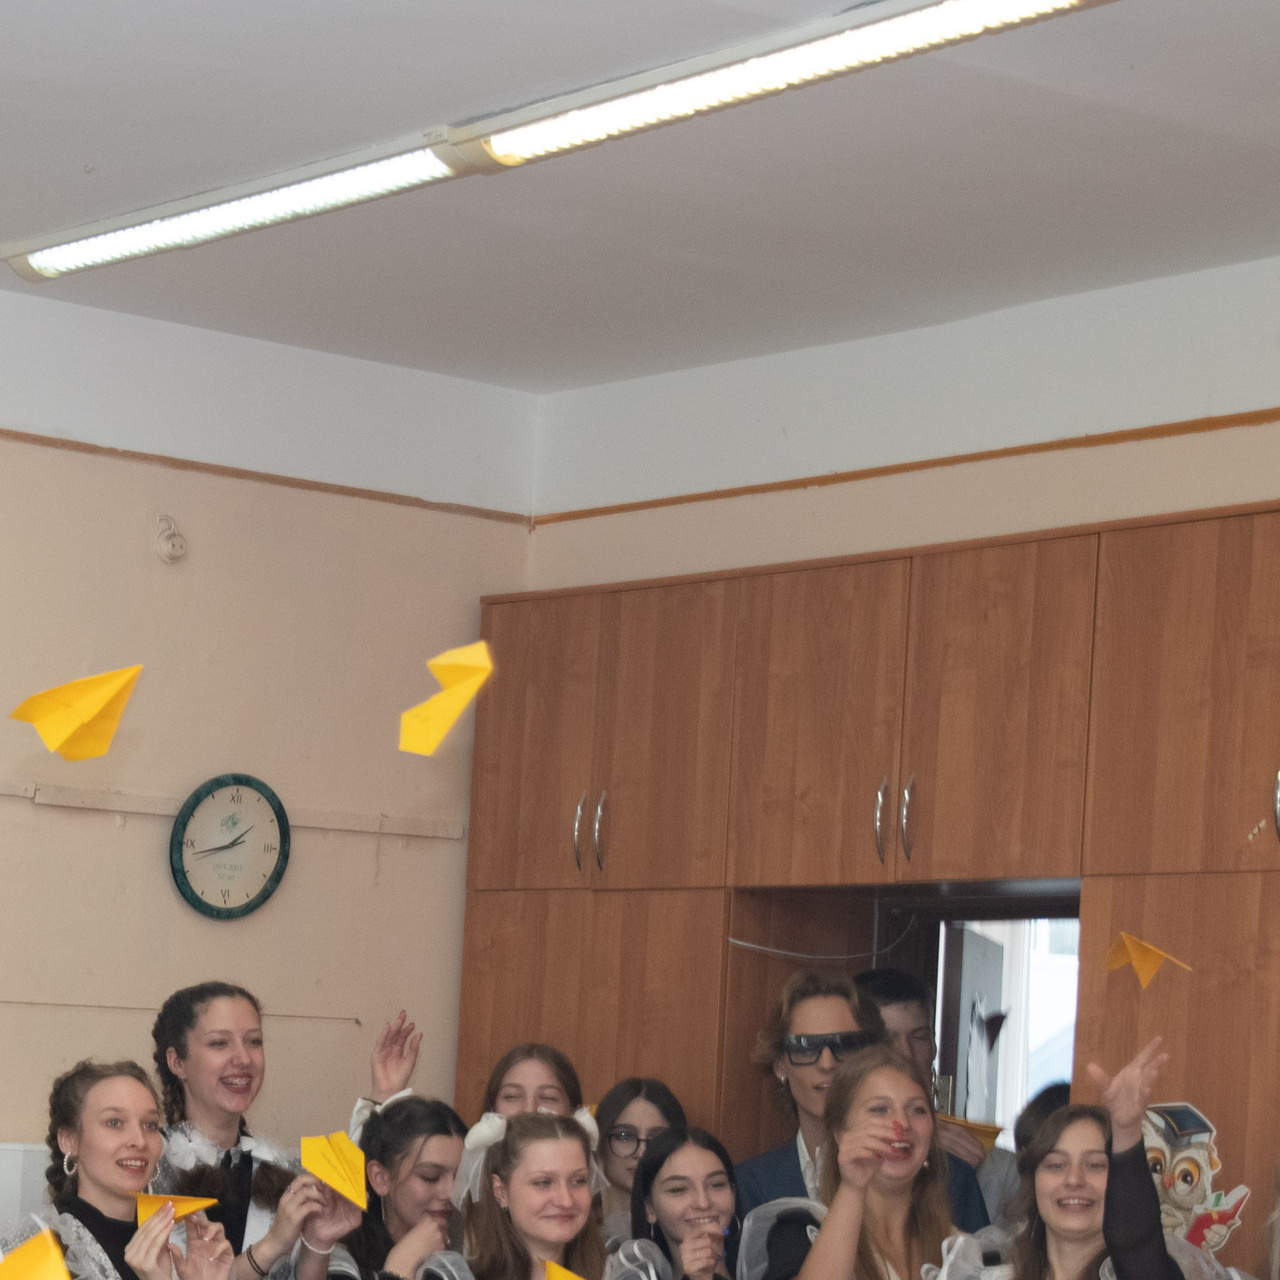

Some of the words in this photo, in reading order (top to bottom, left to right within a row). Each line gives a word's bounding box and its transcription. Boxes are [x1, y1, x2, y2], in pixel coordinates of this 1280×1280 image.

[229, 794, 242, 804] XII
[185, 838, 196, 849] IX
[263, 843, 272, 853] III
[220, 889, 230, 899] VI
